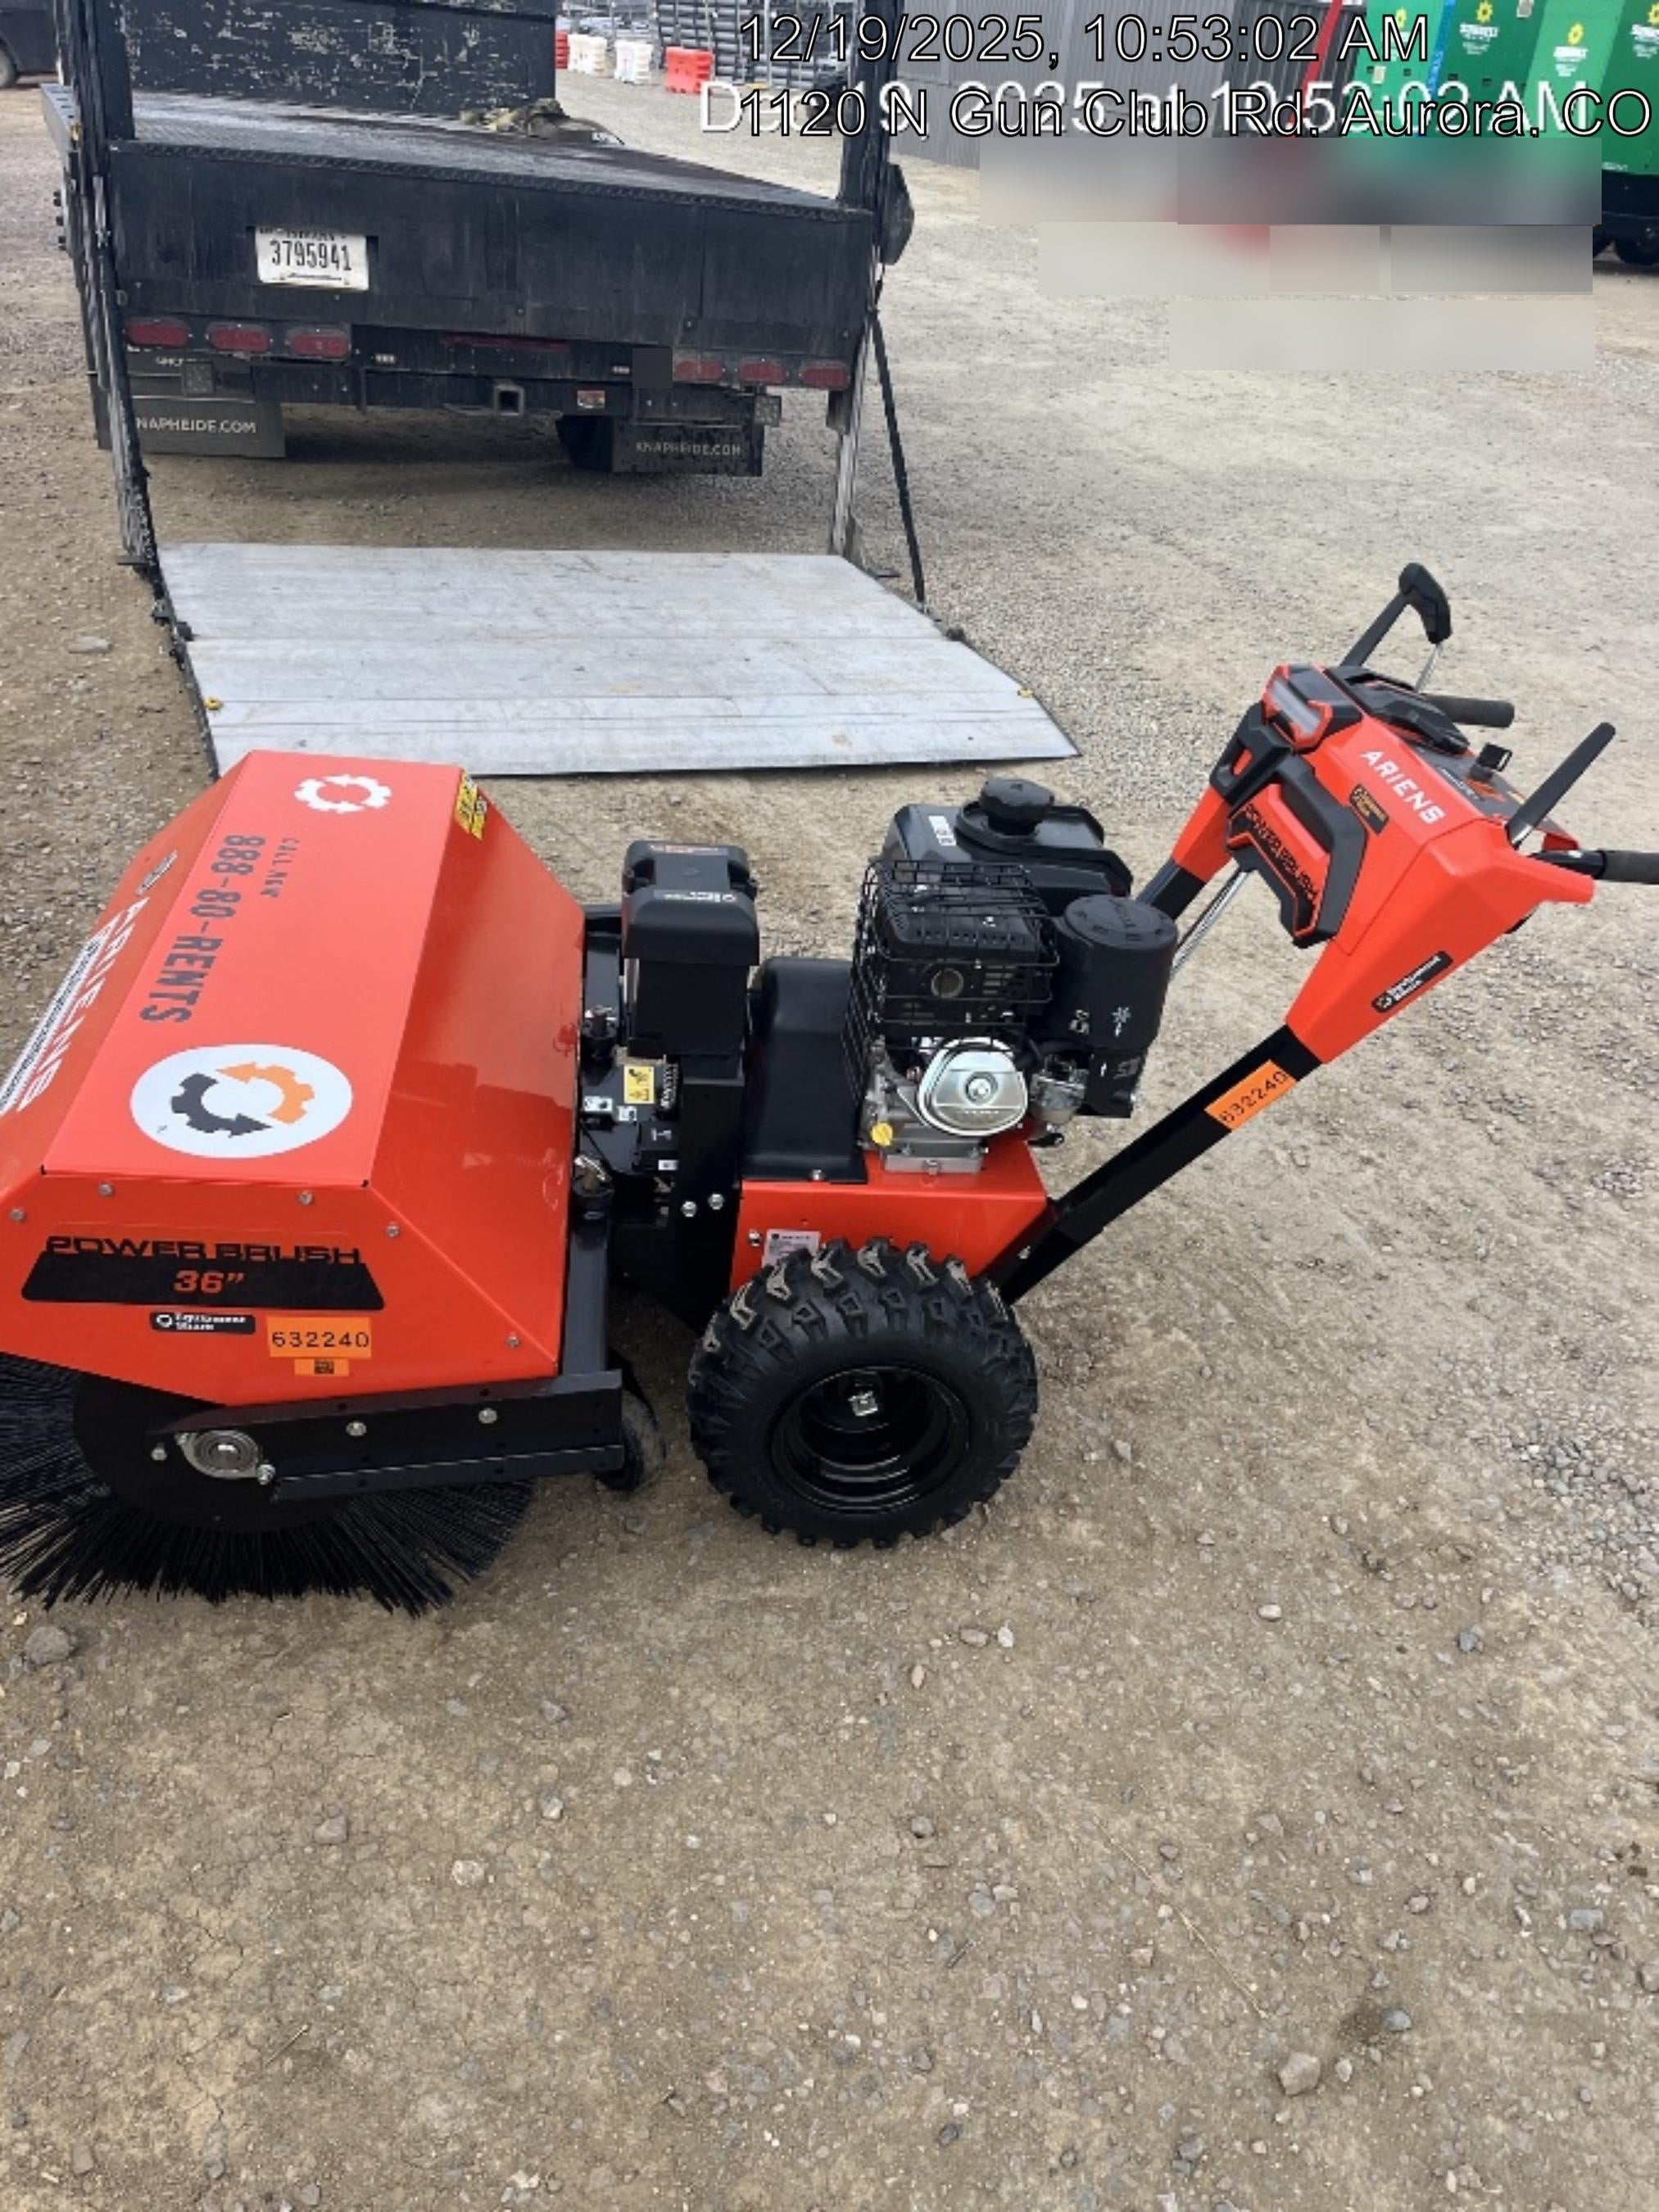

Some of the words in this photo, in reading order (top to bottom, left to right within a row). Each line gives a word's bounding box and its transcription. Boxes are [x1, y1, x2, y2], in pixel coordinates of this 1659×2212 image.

[270, 239, 352, 271] 3795941
[136, 416, 256, 434] NAPHEIDE.COM
[1359, 750, 1447, 824] ARIENS
[139, 835, 266, 1023] 888-80-RENTS
[1218, 1070, 1289, 1123] 632240
[46, 1235, 206, 1260] POWER
[215, 1243, 360, 1265] BRUSH
[271, 1331, 369, 1349] 632240
